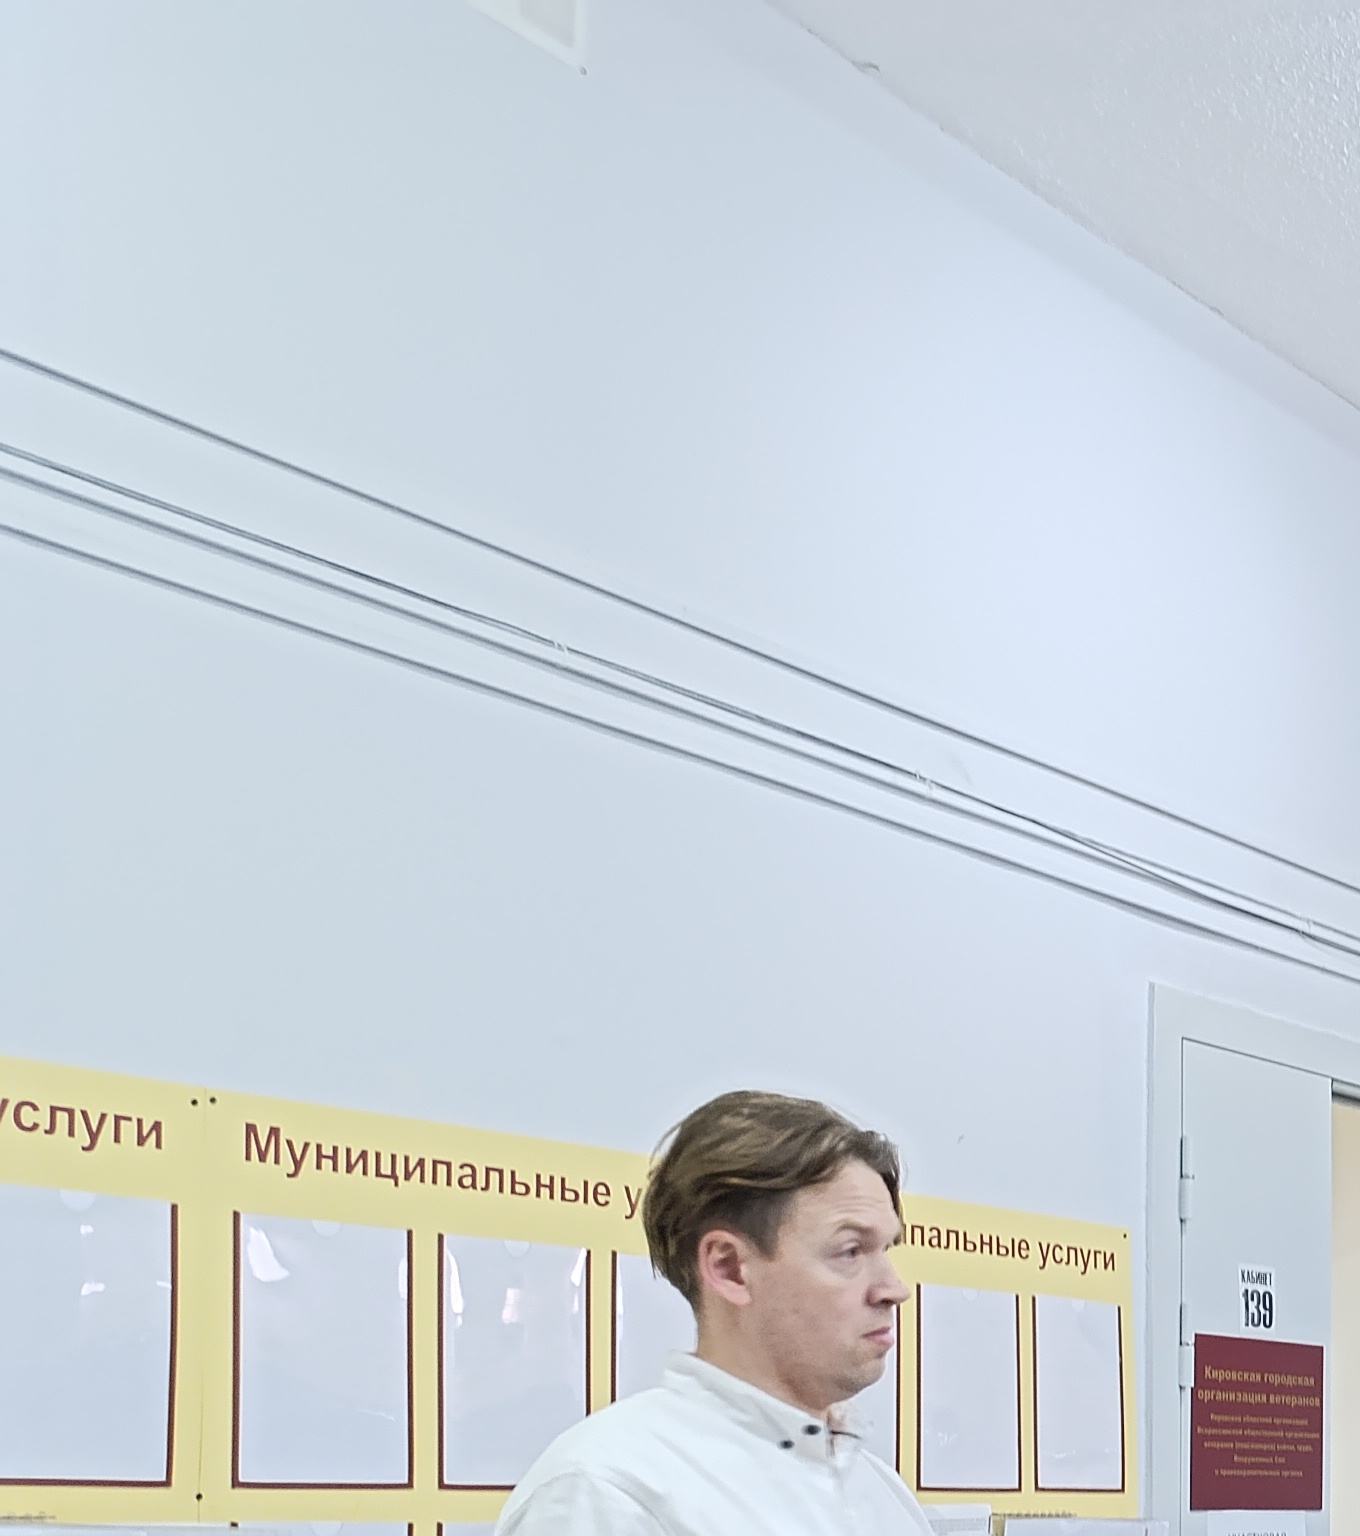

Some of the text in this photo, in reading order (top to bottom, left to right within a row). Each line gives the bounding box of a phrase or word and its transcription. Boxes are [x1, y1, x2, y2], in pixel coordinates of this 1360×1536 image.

[245, 1122, 612, 1208] Муниципальные
[1038, 1240, 1117, 1275] услуги
[1240, 1269, 1273, 1287] КАБИНЕТ
[1242, 1288, 1273, 1329] 139
[1204, 1364, 1315, 1390] Кировская городская
[1197, 1388, 1321, 1408] организация ветеранов
